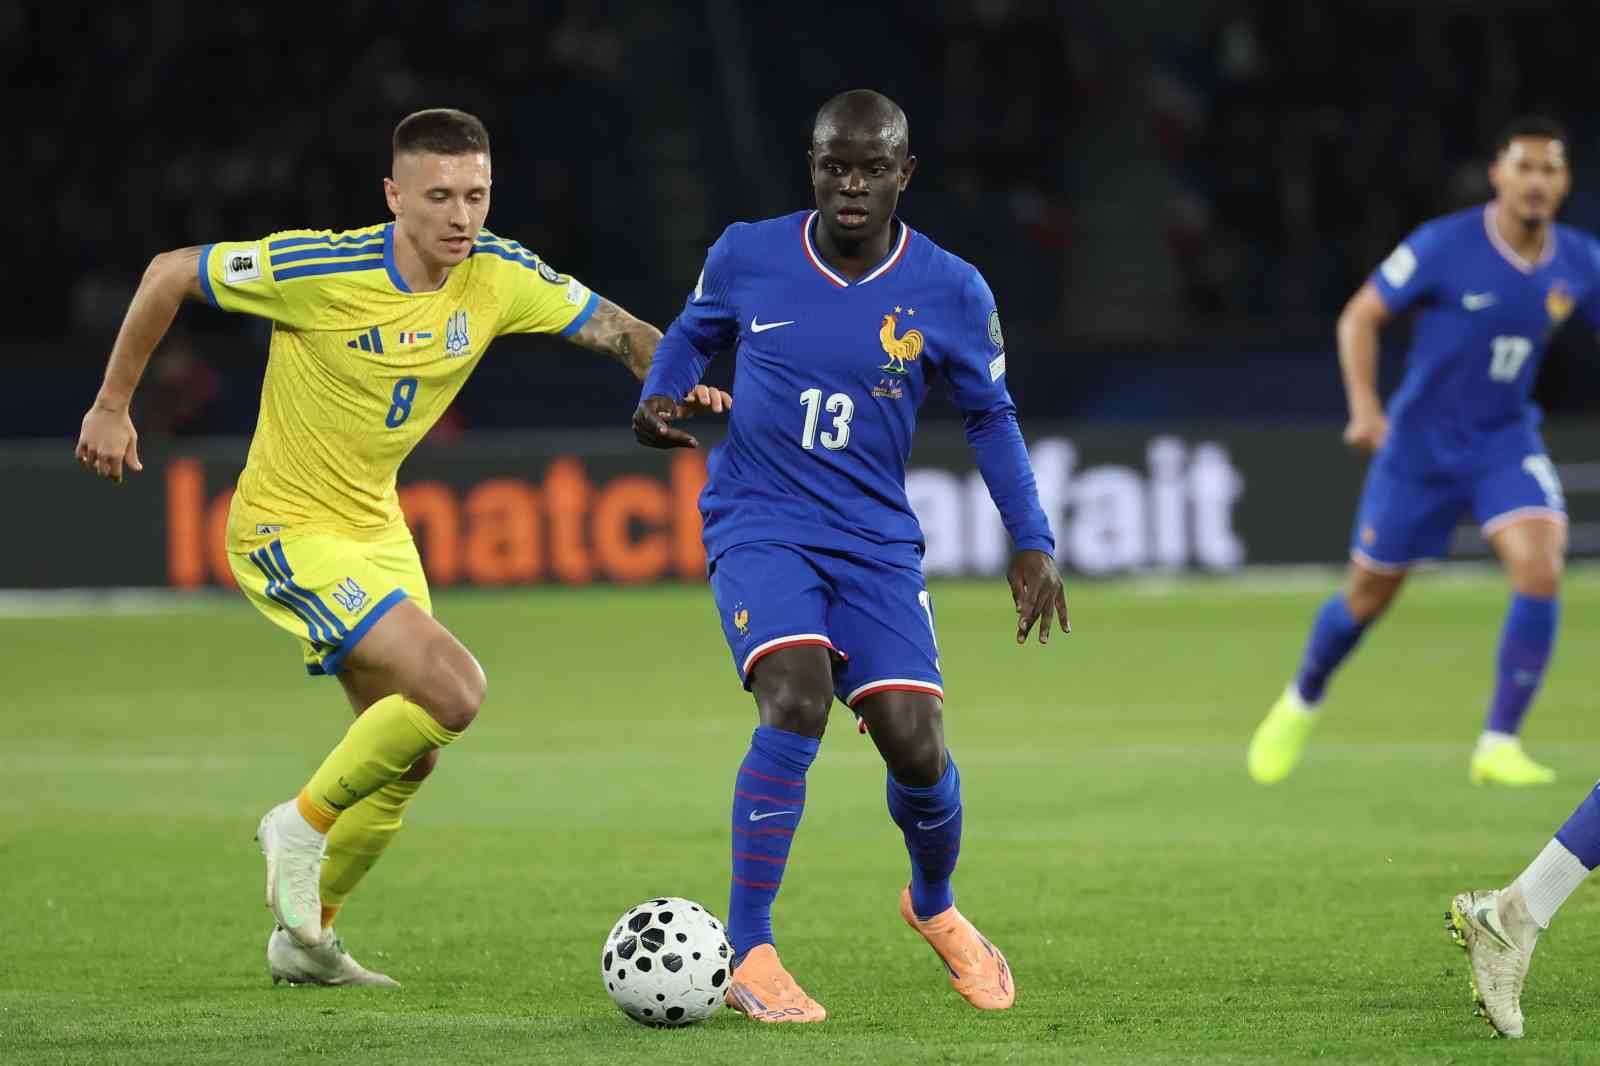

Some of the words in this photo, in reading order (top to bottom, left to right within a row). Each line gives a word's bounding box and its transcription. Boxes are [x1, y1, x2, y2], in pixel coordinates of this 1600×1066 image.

[1490, 336, 1532, 384] 17
[385, 376, 418, 429] 8
[799, 388, 854, 450] 13
